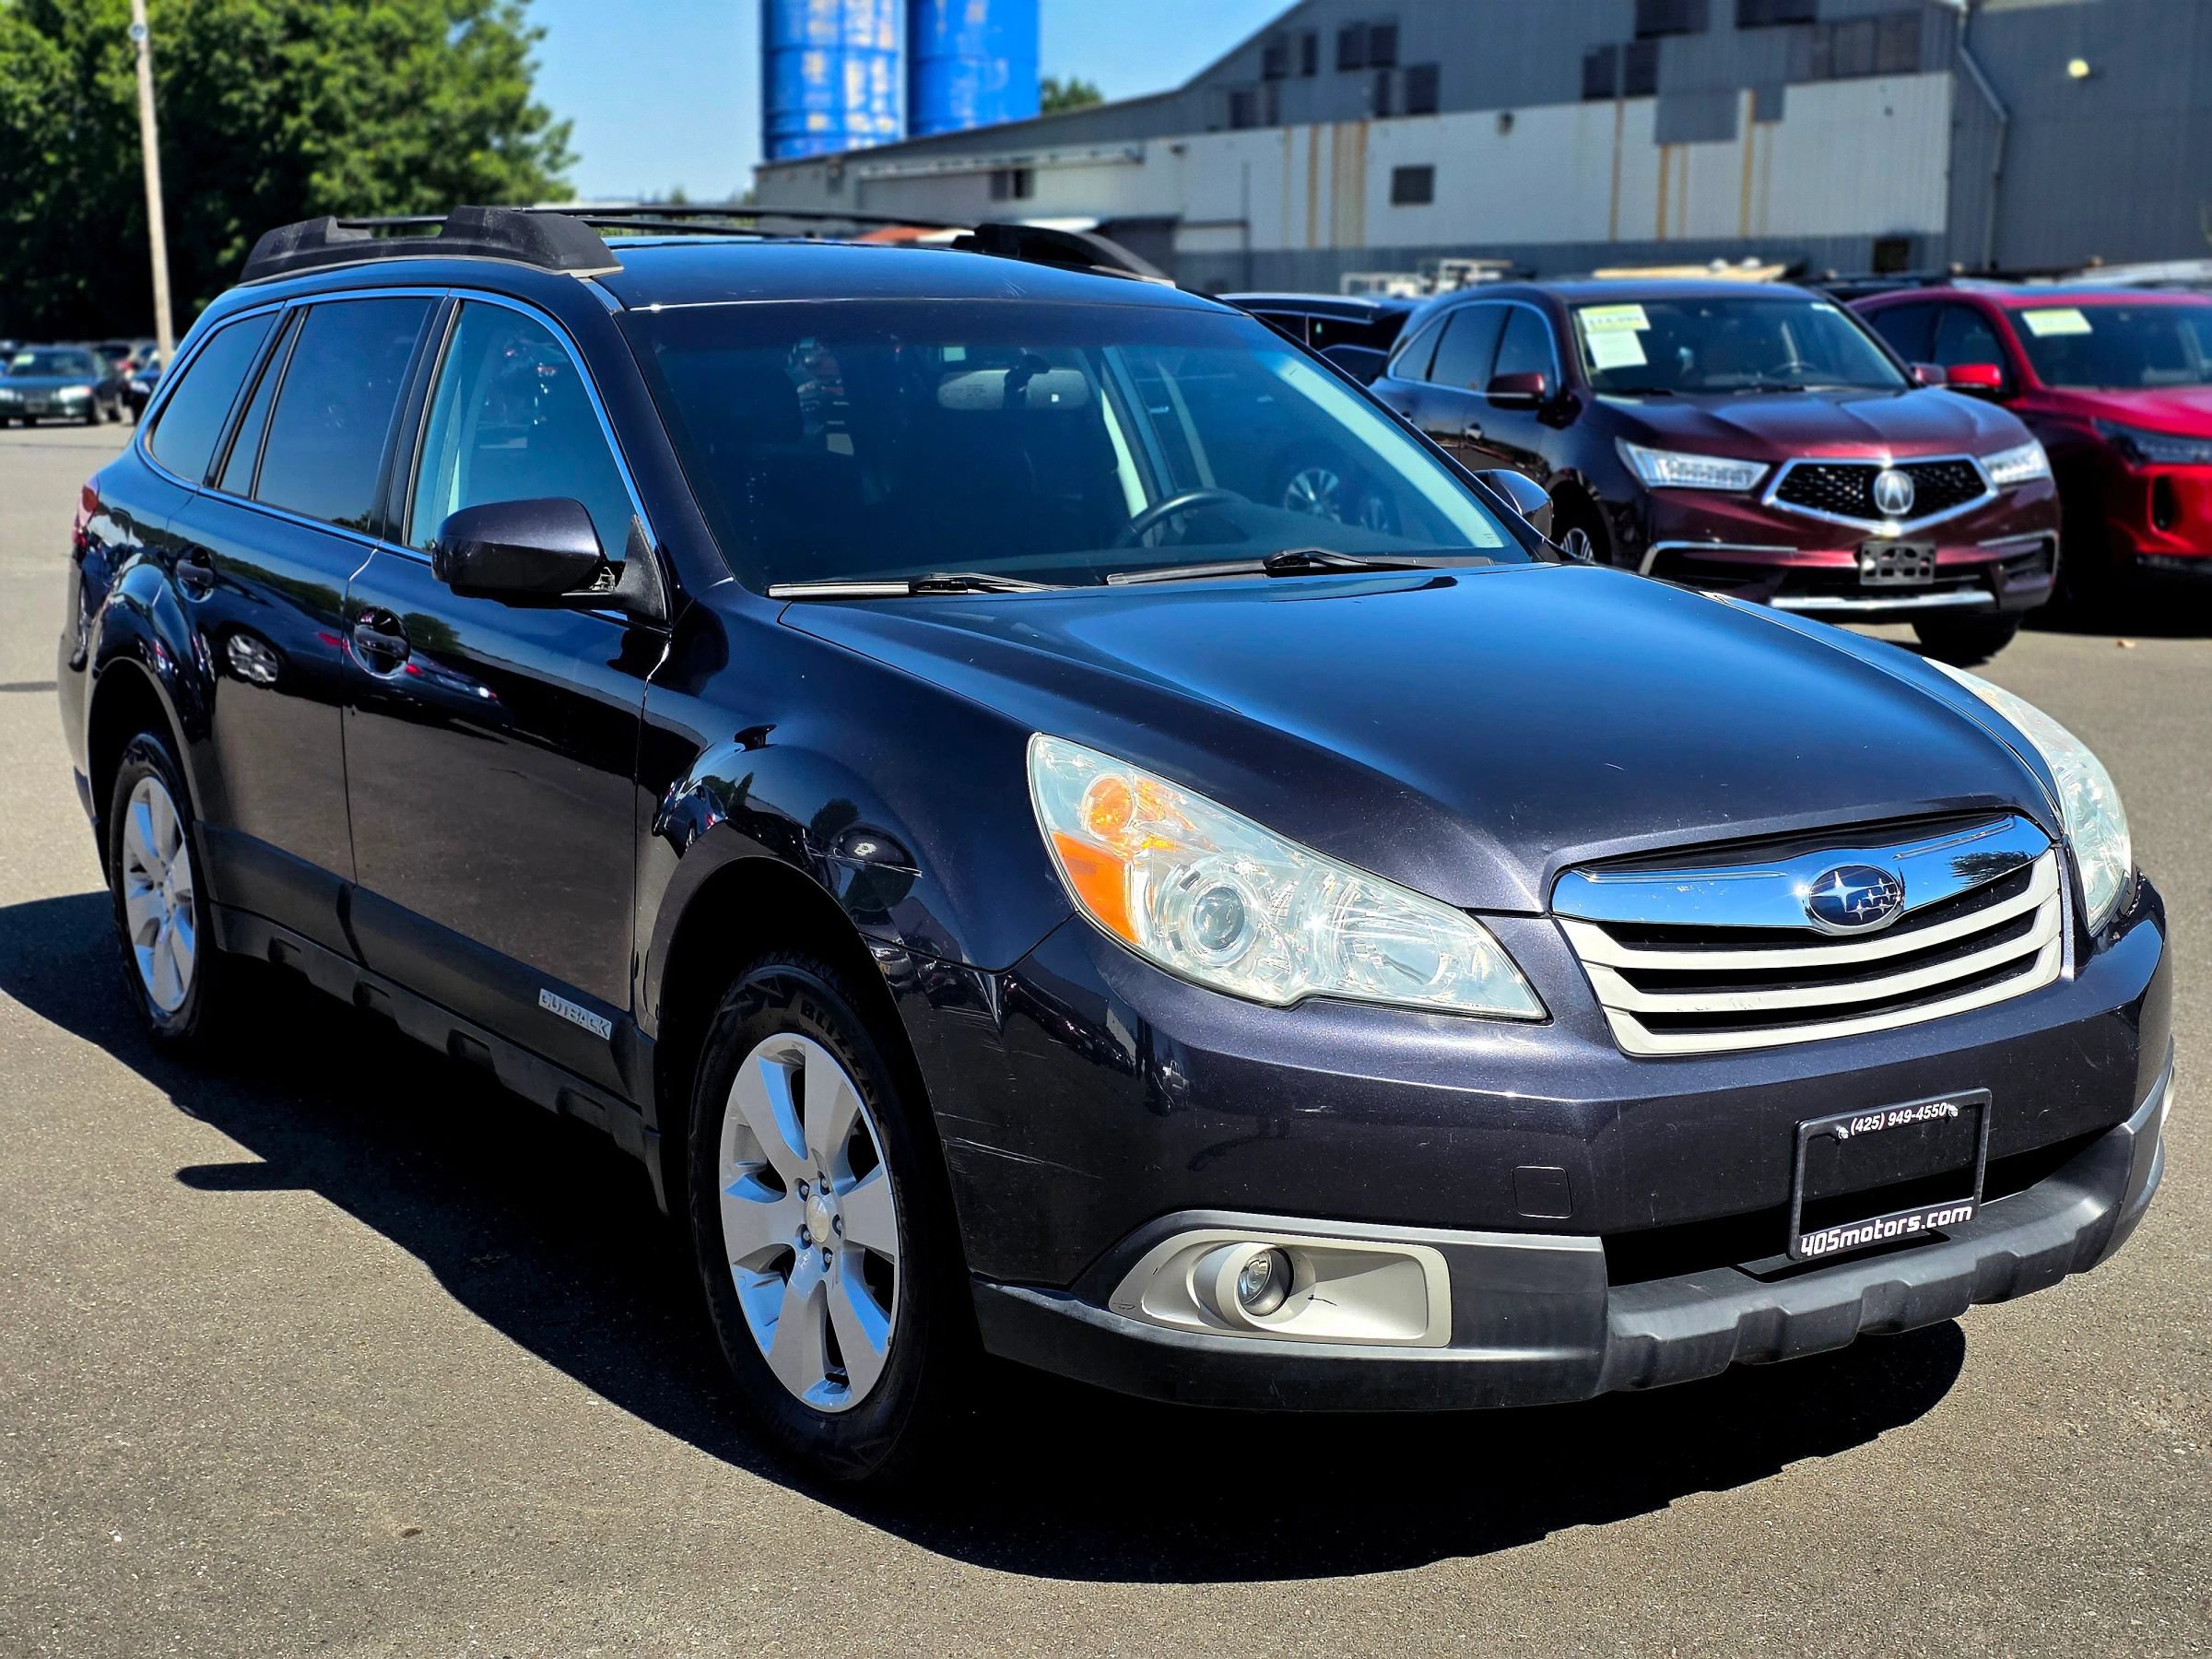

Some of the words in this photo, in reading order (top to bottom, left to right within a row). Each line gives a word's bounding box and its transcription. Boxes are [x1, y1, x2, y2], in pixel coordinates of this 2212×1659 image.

[540, 992, 609, 1038] OUTBACK
[1851, 1111, 1885, 1135] (425)
[1888, 1102, 1947, 1126] 949-4550
[1801, 1206, 1972, 1256] 405motors.com
